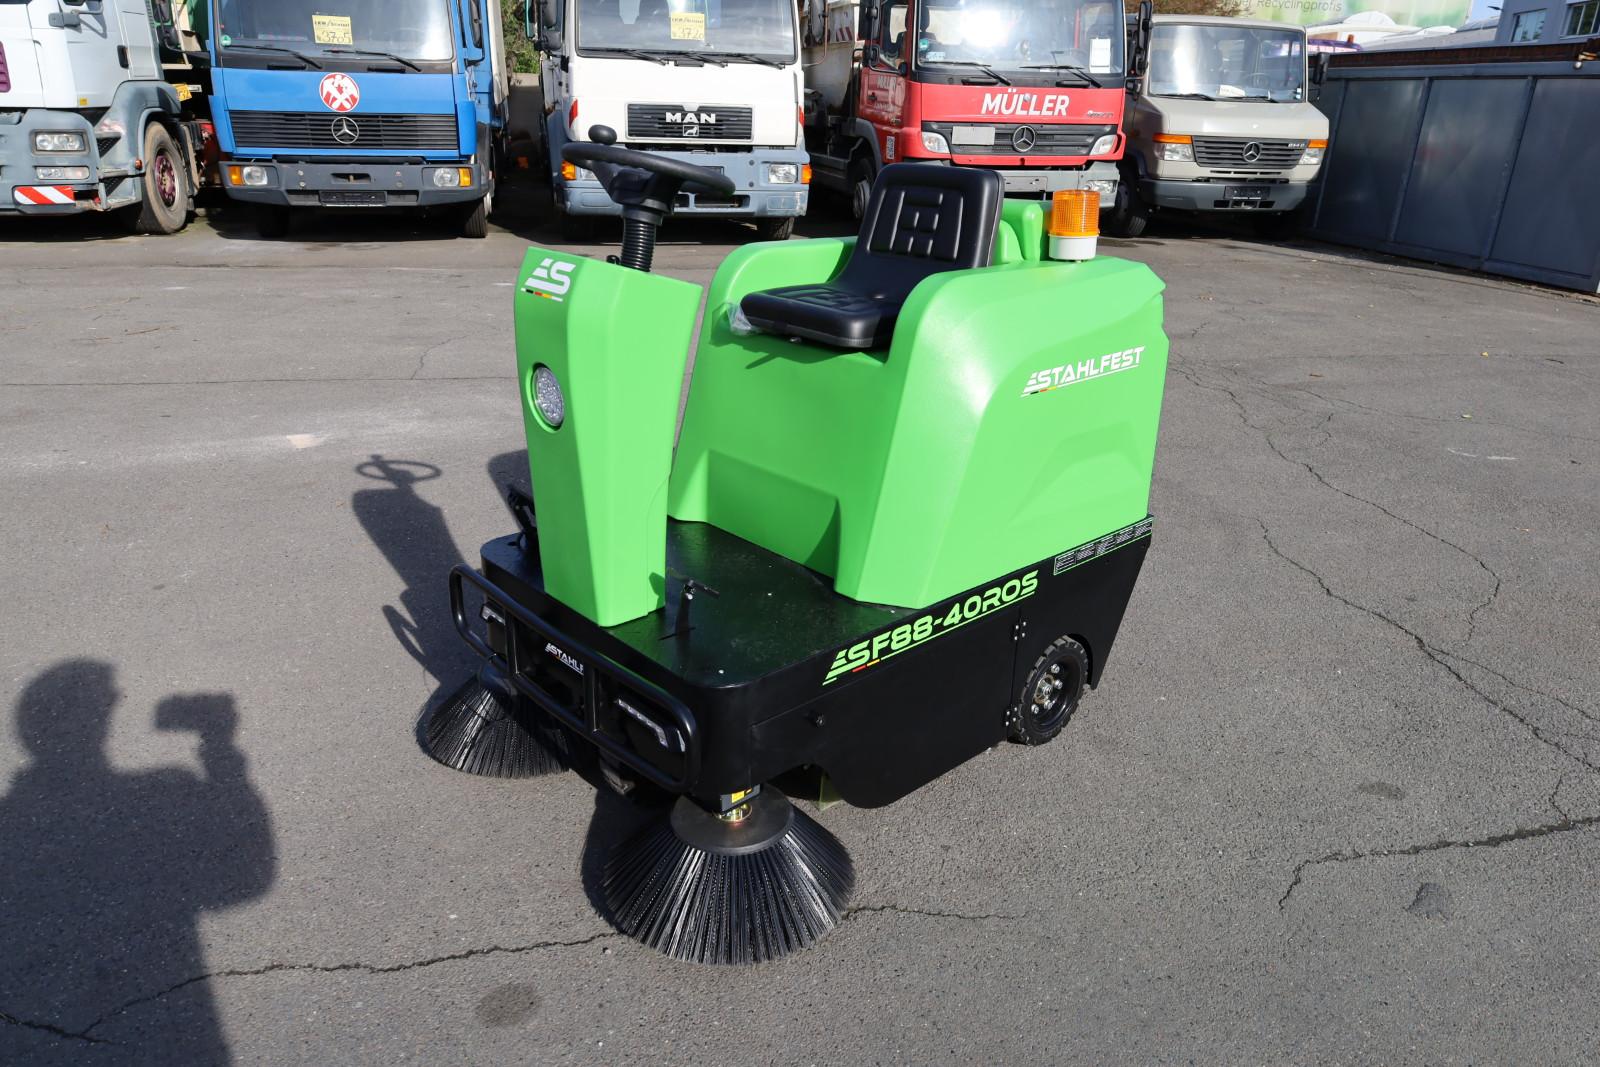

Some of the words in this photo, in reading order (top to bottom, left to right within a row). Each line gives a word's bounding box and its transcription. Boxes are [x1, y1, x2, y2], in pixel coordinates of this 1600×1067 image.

[1256, 0, 1342, 14] Recyclingprofis
[981, 88, 1070, 116] MÜLLER
[665, 111, 716, 124] MAN
[1022, 346, 1145, 394] STAHLFEST
[545, 642, 584, 673] STAHLF
